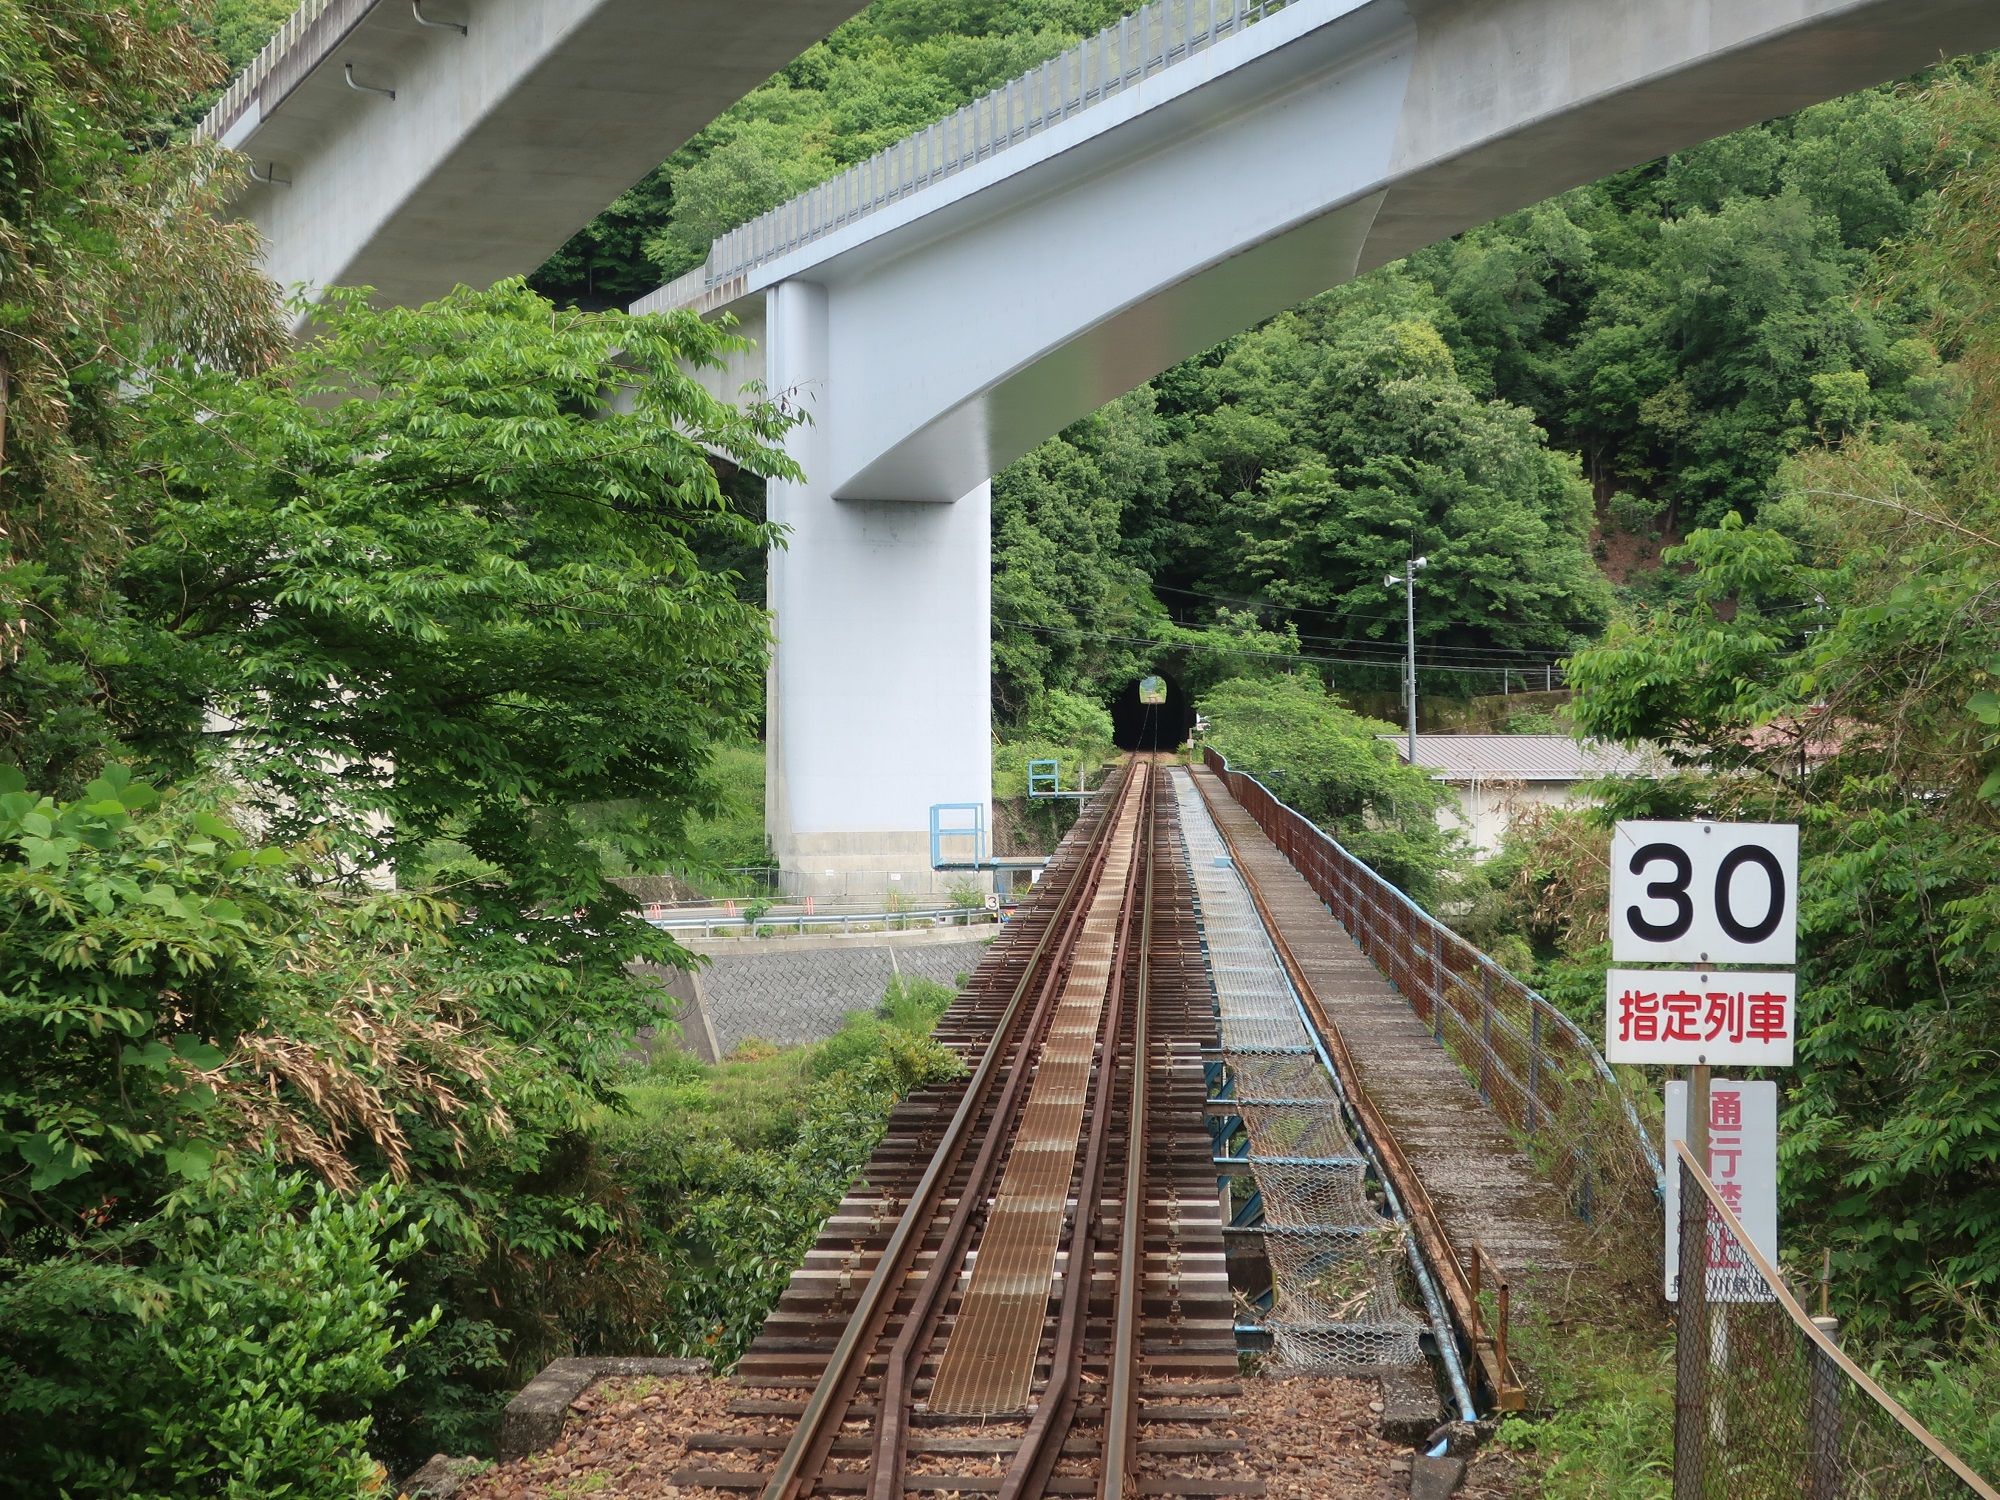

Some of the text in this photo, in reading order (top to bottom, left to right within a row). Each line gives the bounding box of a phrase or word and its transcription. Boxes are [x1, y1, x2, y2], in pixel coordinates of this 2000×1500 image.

[988, 896, 997, 909] 3
[1626, 842, 1786, 944] 30
[1618, 989, 1788, 1045] 指定列車
